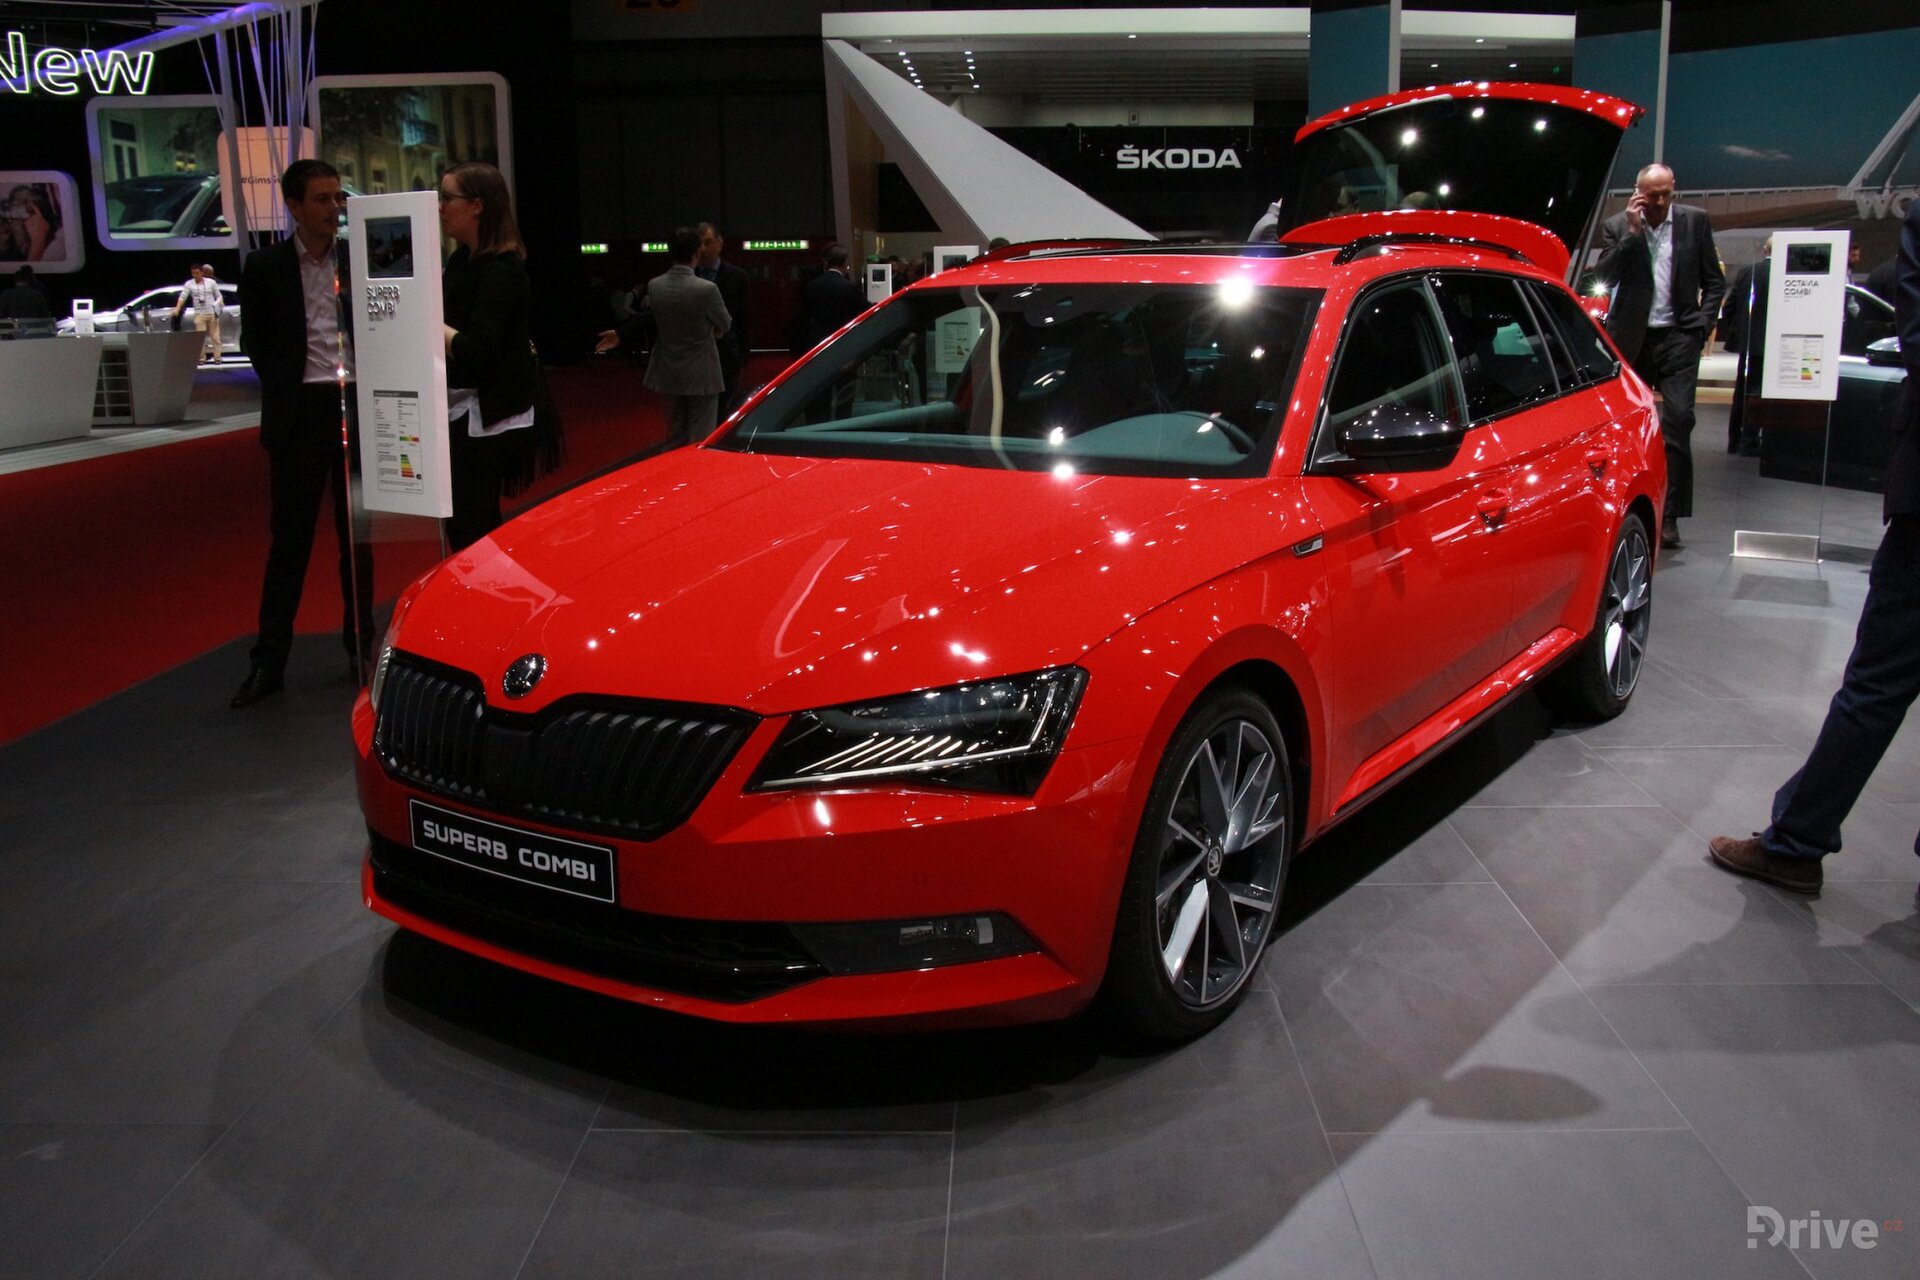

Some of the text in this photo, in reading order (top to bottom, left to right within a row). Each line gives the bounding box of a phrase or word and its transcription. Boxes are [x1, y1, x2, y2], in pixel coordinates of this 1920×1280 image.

[1116, 144, 1242, 169] ŠKODA
[1783, 288, 1811, 296] COMBI
[423, 820, 596, 882] SUPERB COMBI
